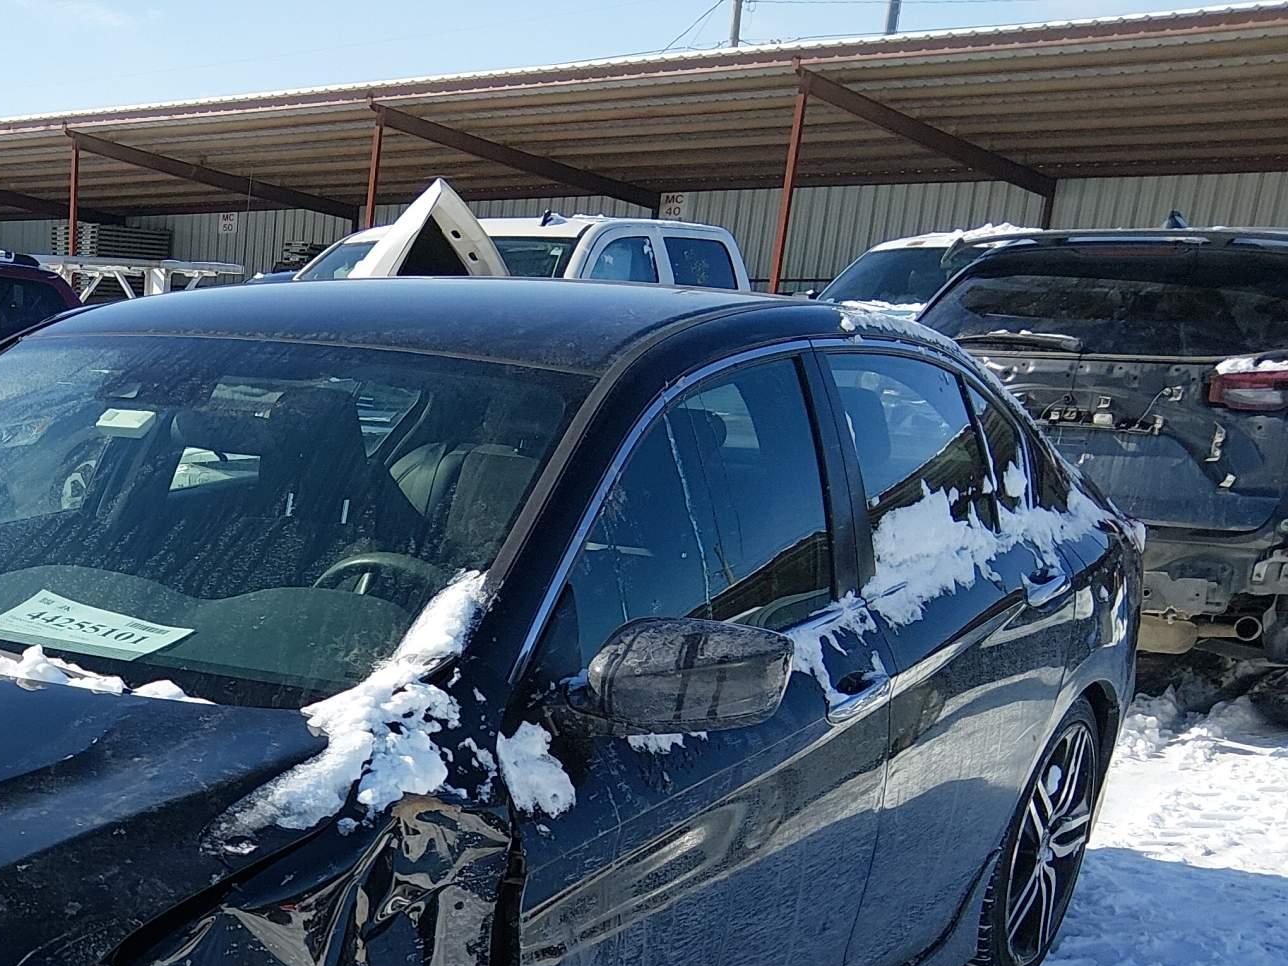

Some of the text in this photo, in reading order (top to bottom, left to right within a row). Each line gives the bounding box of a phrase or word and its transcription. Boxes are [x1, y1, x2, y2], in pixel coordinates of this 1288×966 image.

[665, 194, 684, 204] MC
[665, 206, 681, 216] 40
[222, 213, 234, 222] MC
[26, 610, 150, 646] 44255101
